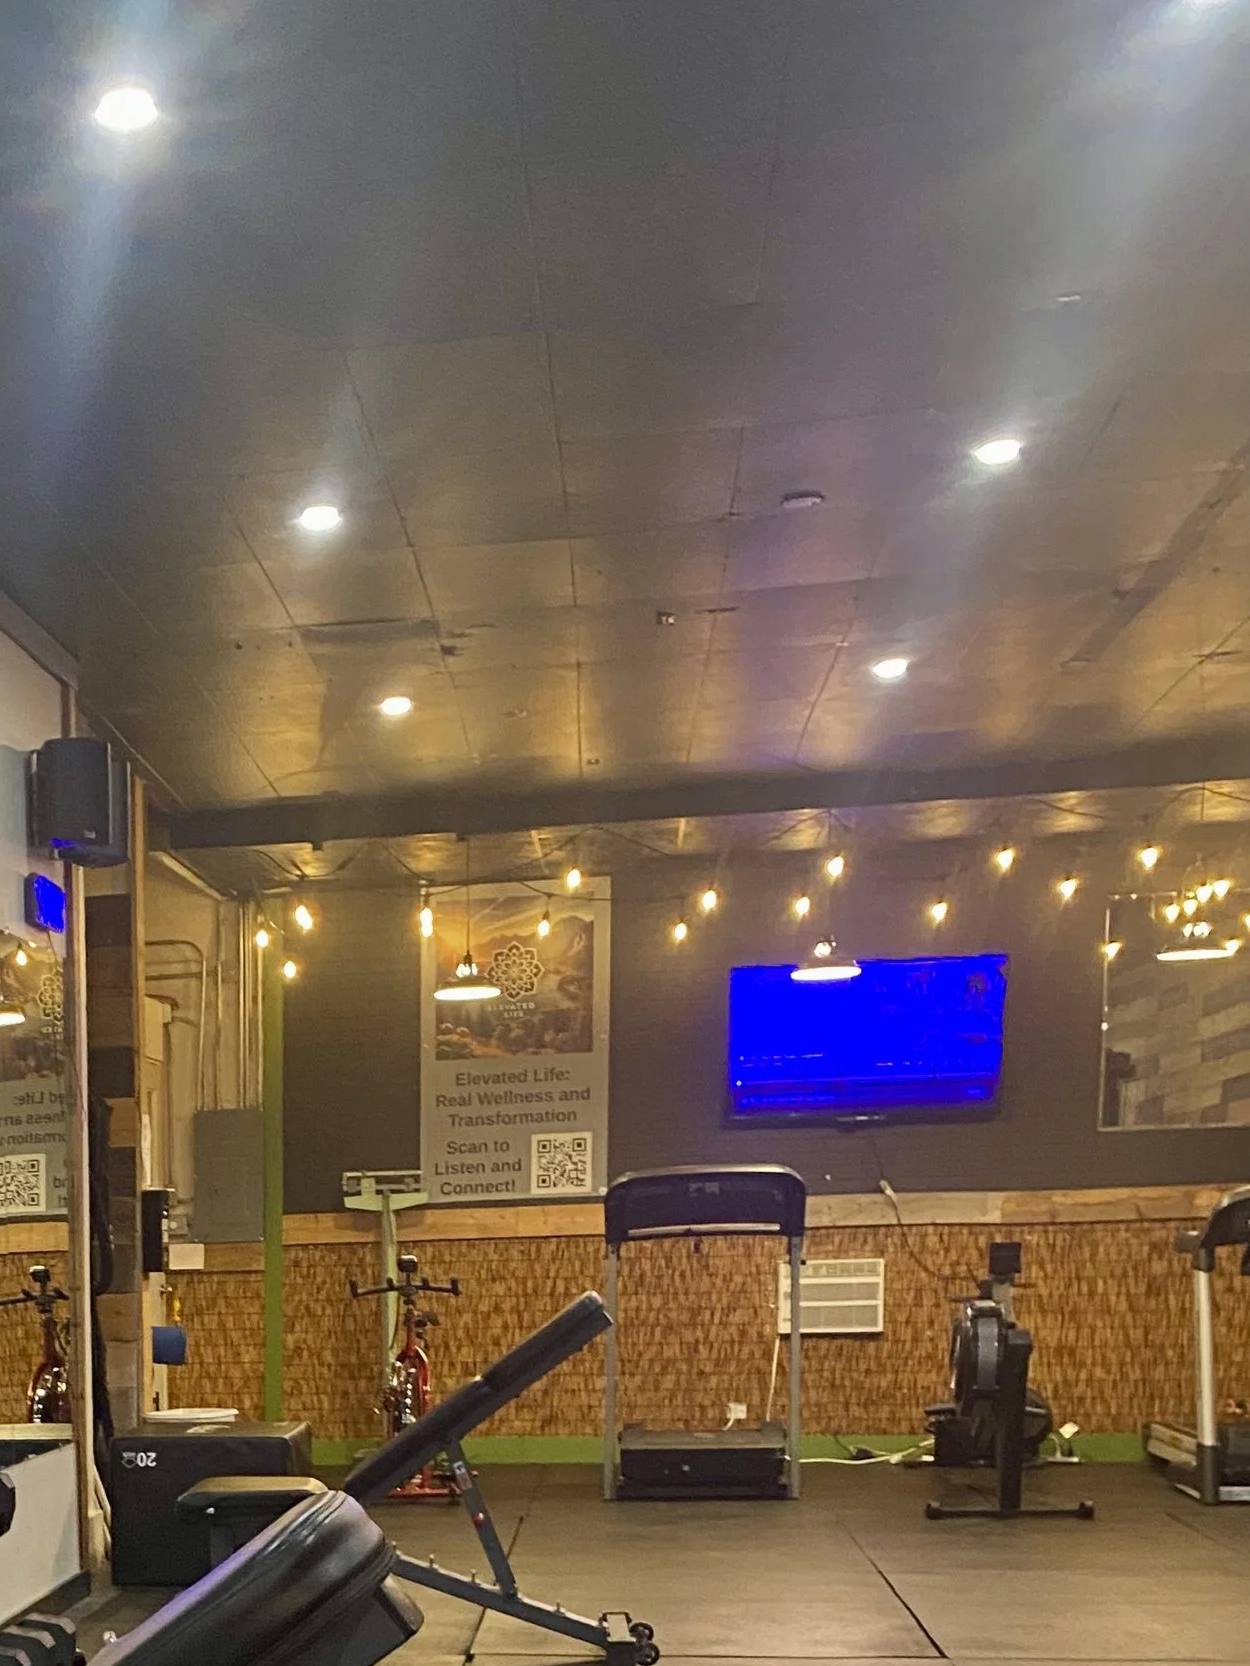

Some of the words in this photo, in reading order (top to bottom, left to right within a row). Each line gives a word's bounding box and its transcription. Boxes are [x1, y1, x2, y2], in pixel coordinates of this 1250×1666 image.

[455, 1070, 527, 1086] Elevated
[533, 1067, 570, 1082] Life:
[436, 1092, 473, 1108] Real
[477, 1089, 553, 1106] Wellness
[558, 1087, 591, 1102] and
[449, 1109, 578, 1128] Transformation
[446, 1140, 488, 1155] Scan
[494, 1140, 510, 1153] to
[434, 1161, 485, 1176] Listen
[491, 1158, 522, 1172] and
[440, 1179, 516, 1195] Connect!
[137, 1451, 157, 1467] 20
